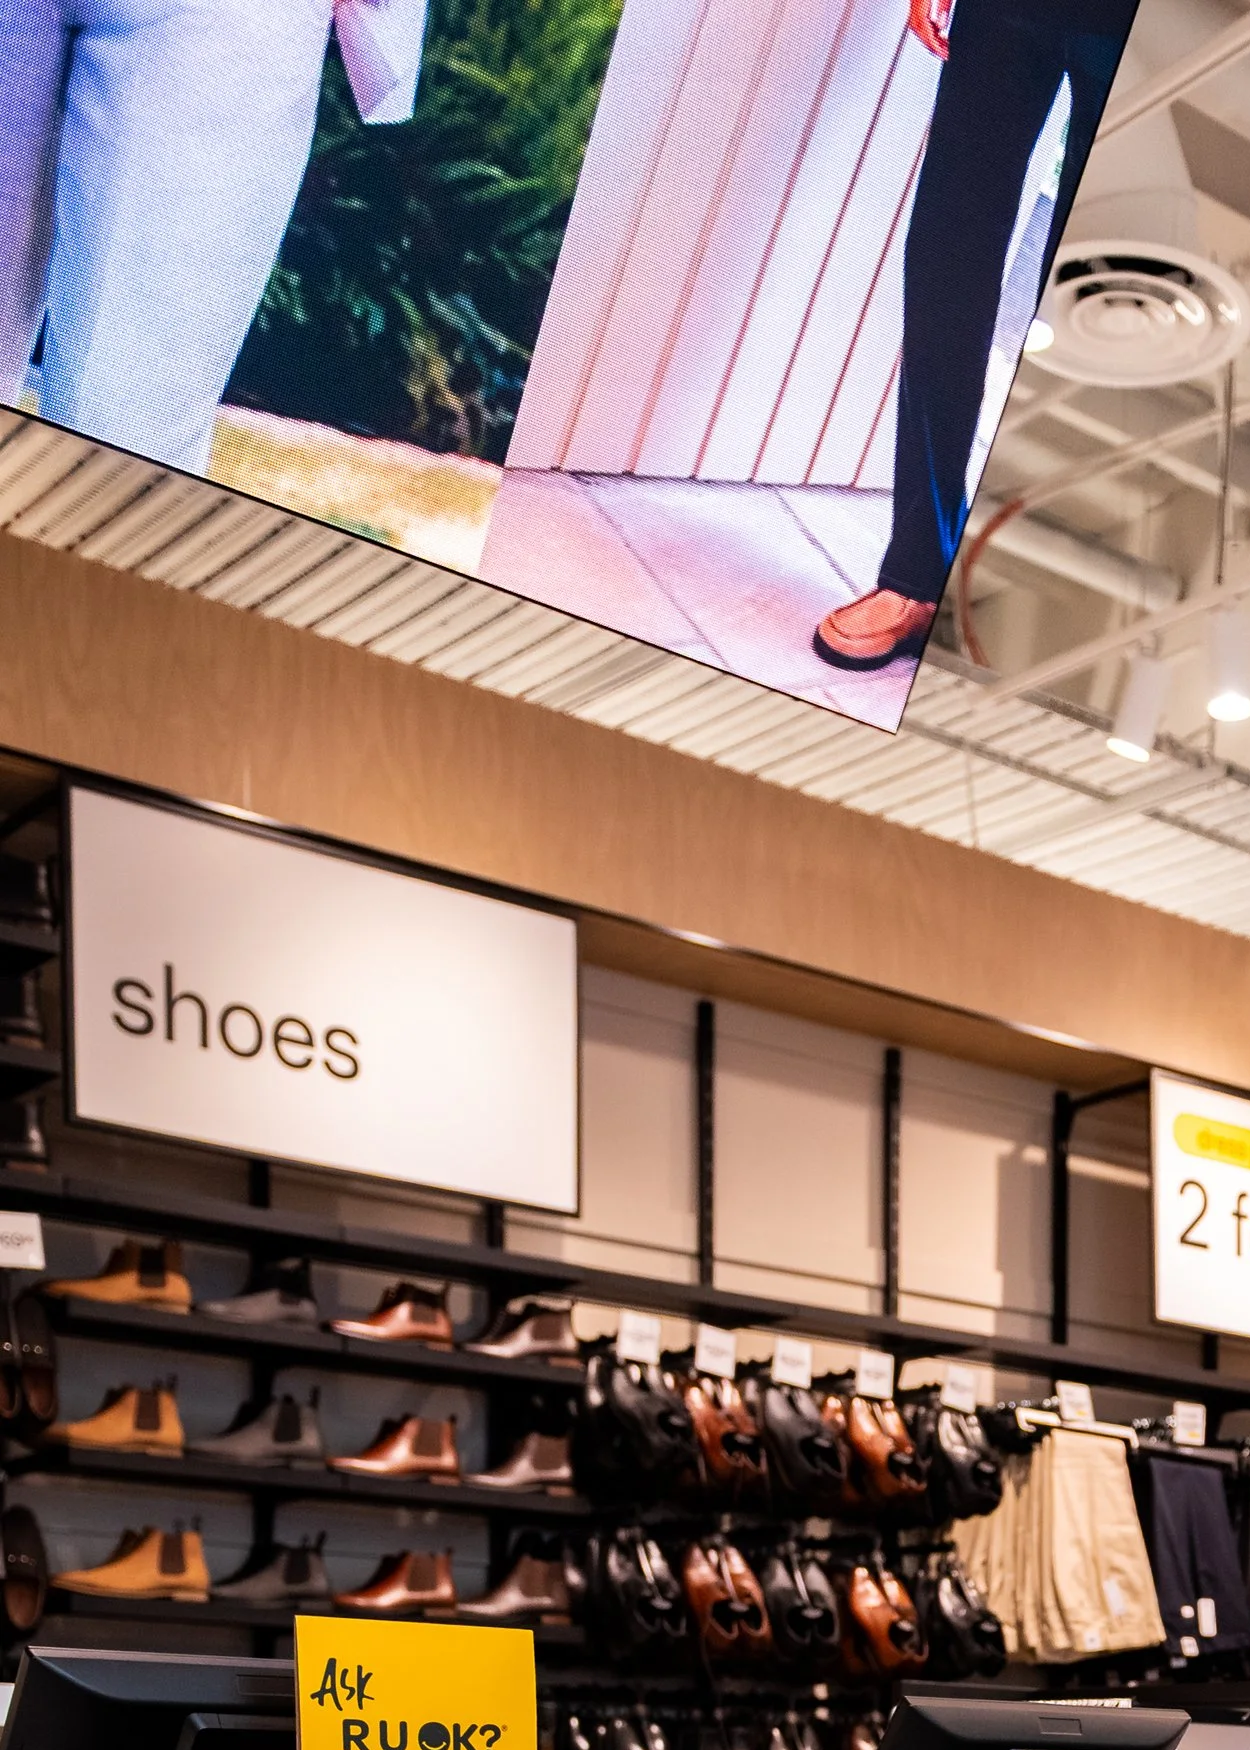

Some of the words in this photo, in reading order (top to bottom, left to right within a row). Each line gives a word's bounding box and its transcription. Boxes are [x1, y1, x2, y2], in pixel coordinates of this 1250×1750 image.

[111, 962, 362, 1081] shoes
[1178, 1180, 1209, 1249] 2
[310, 1657, 375, 1712] Ask
